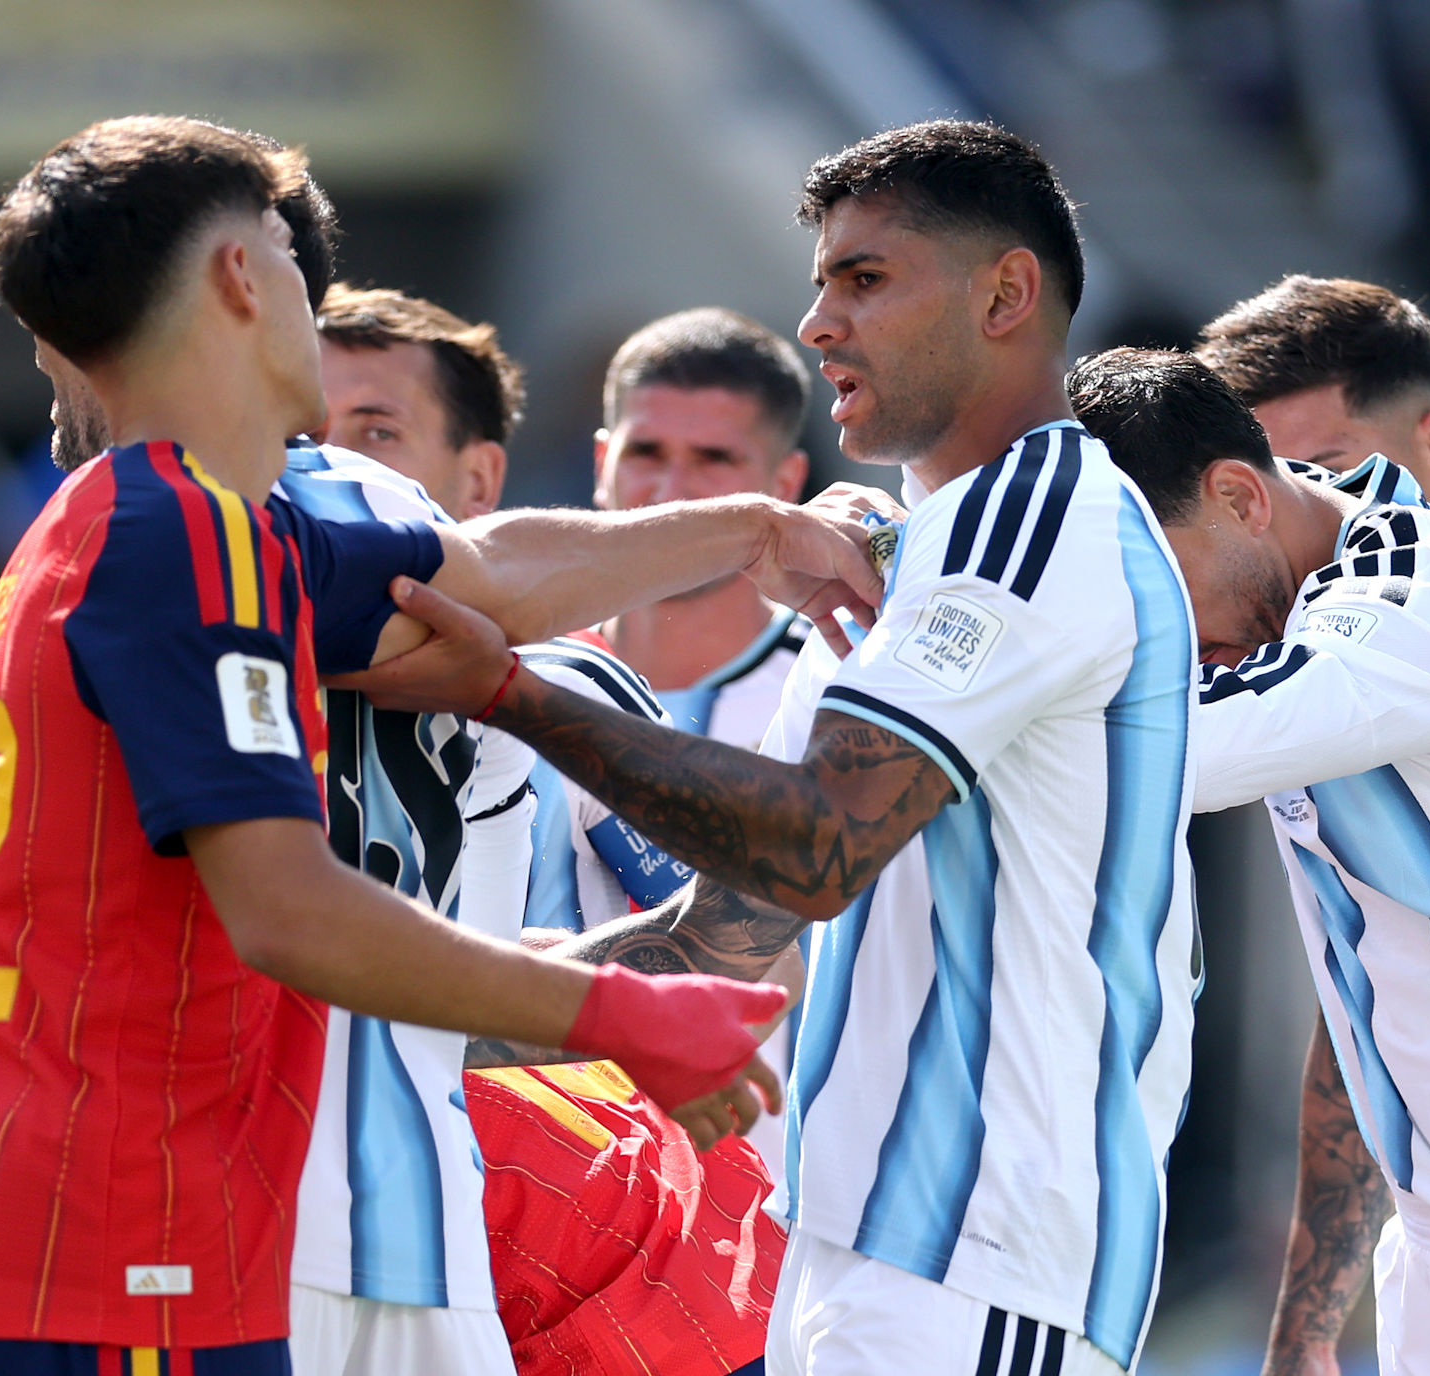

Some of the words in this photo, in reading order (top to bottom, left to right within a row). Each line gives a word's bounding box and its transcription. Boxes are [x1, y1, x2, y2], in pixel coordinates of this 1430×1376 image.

[927, 615, 981, 655] UNITES
[935, 602, 987, 639] FOOTBALL
[923, 653, 945, 672] FIFA
[933, 640, 974, 674] World
